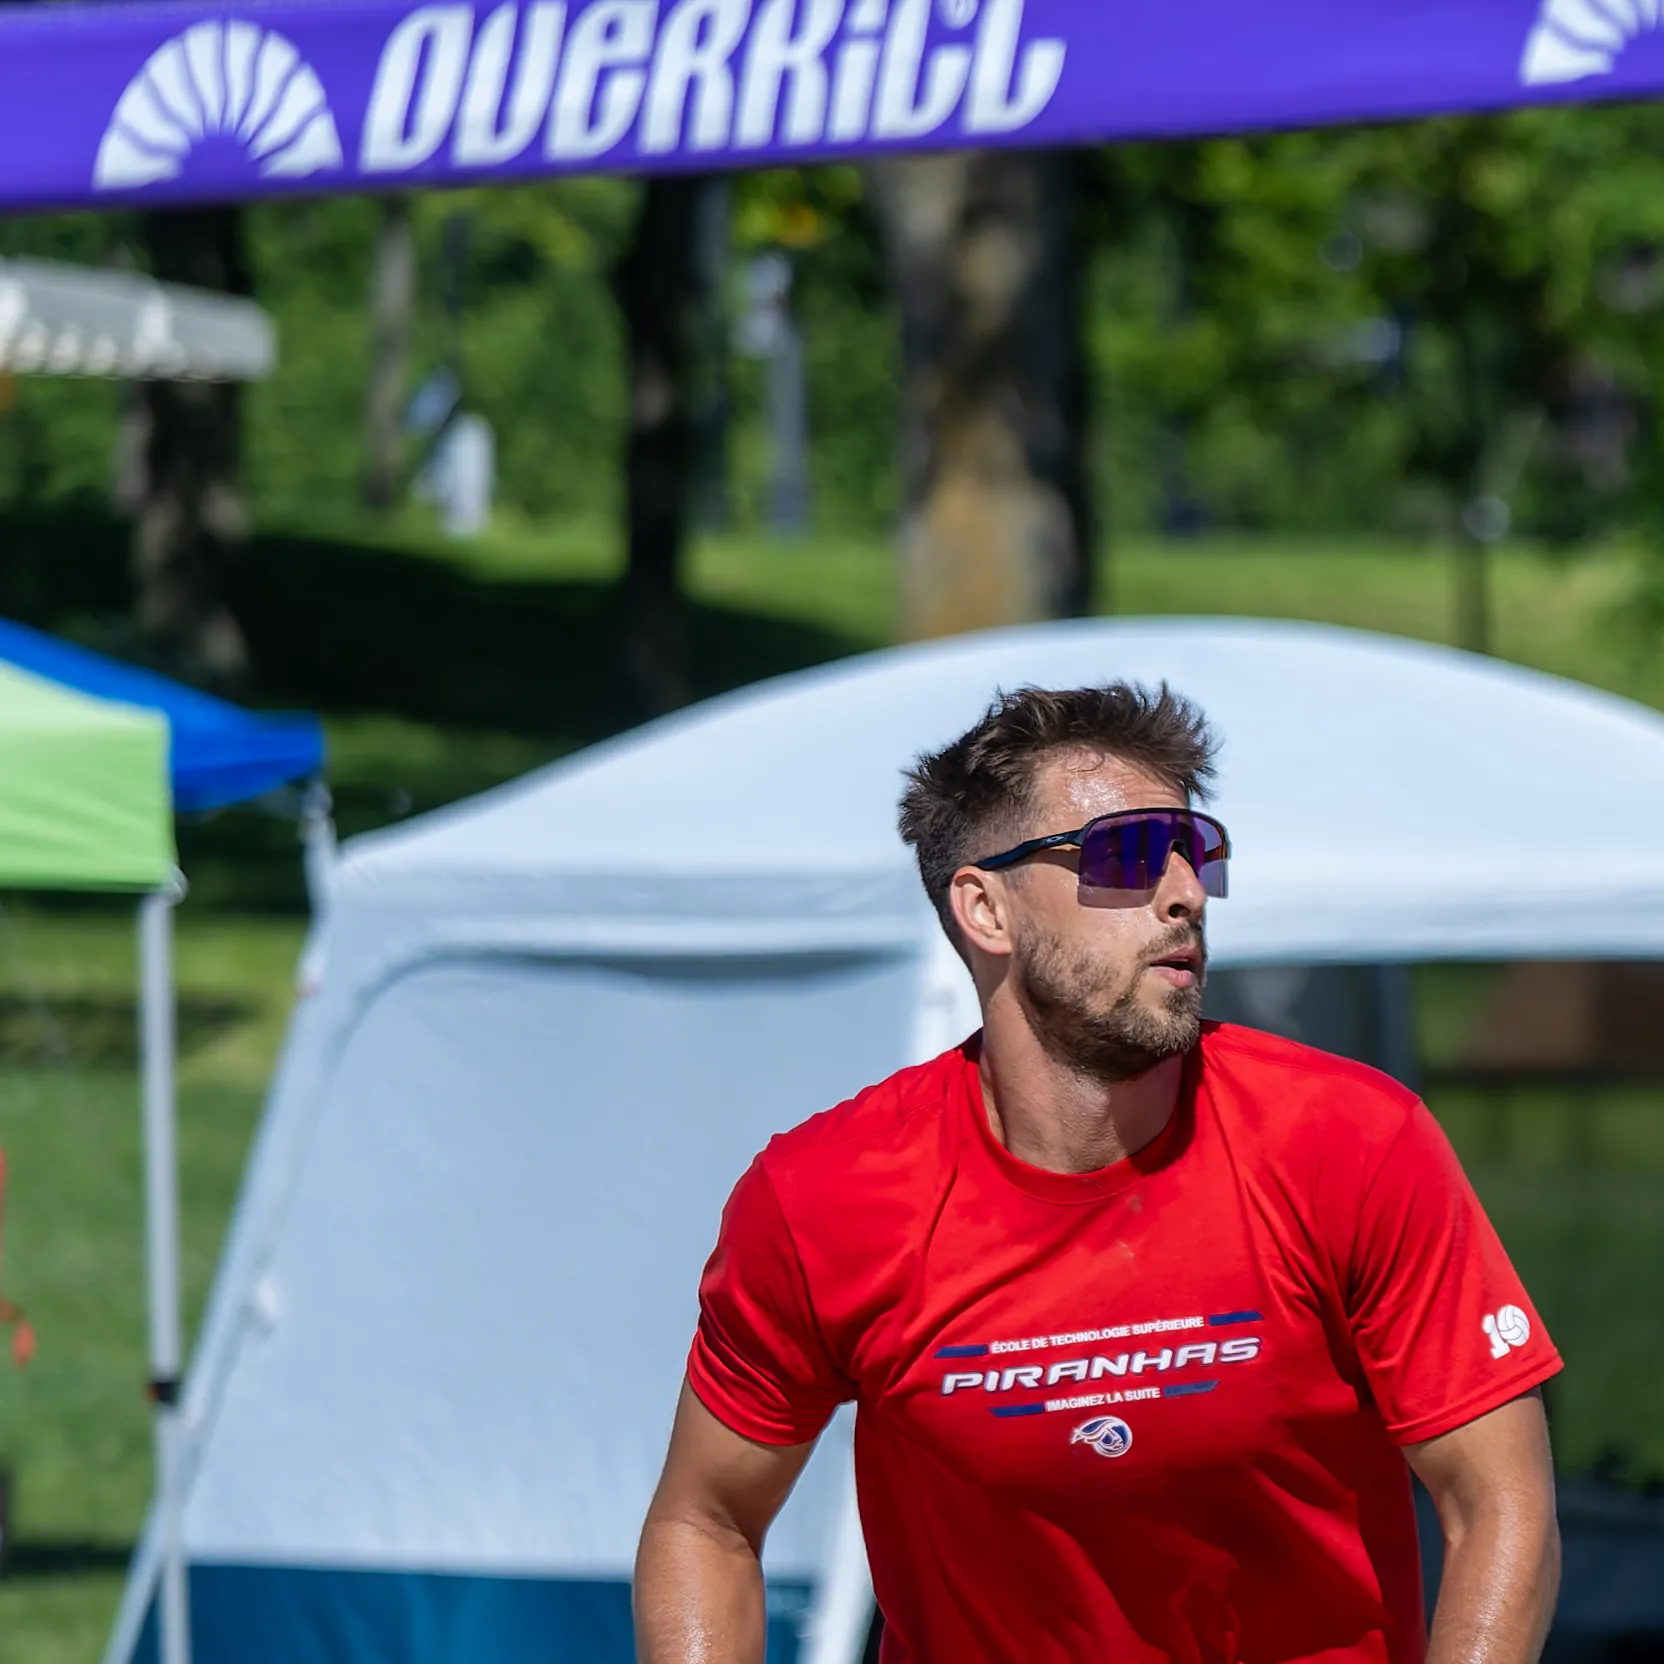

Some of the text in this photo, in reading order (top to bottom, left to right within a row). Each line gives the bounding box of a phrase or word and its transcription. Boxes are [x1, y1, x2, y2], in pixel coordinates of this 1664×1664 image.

[991, 1316, 1205, 1354] ÉCOLE DE TECHNOLOGIE SUPÉRIEURE
[940, 1336, 1263, 1396] PIRANHAS
[1045, 1387, 1161, 1412] IMAGINEZ LA SUITE
